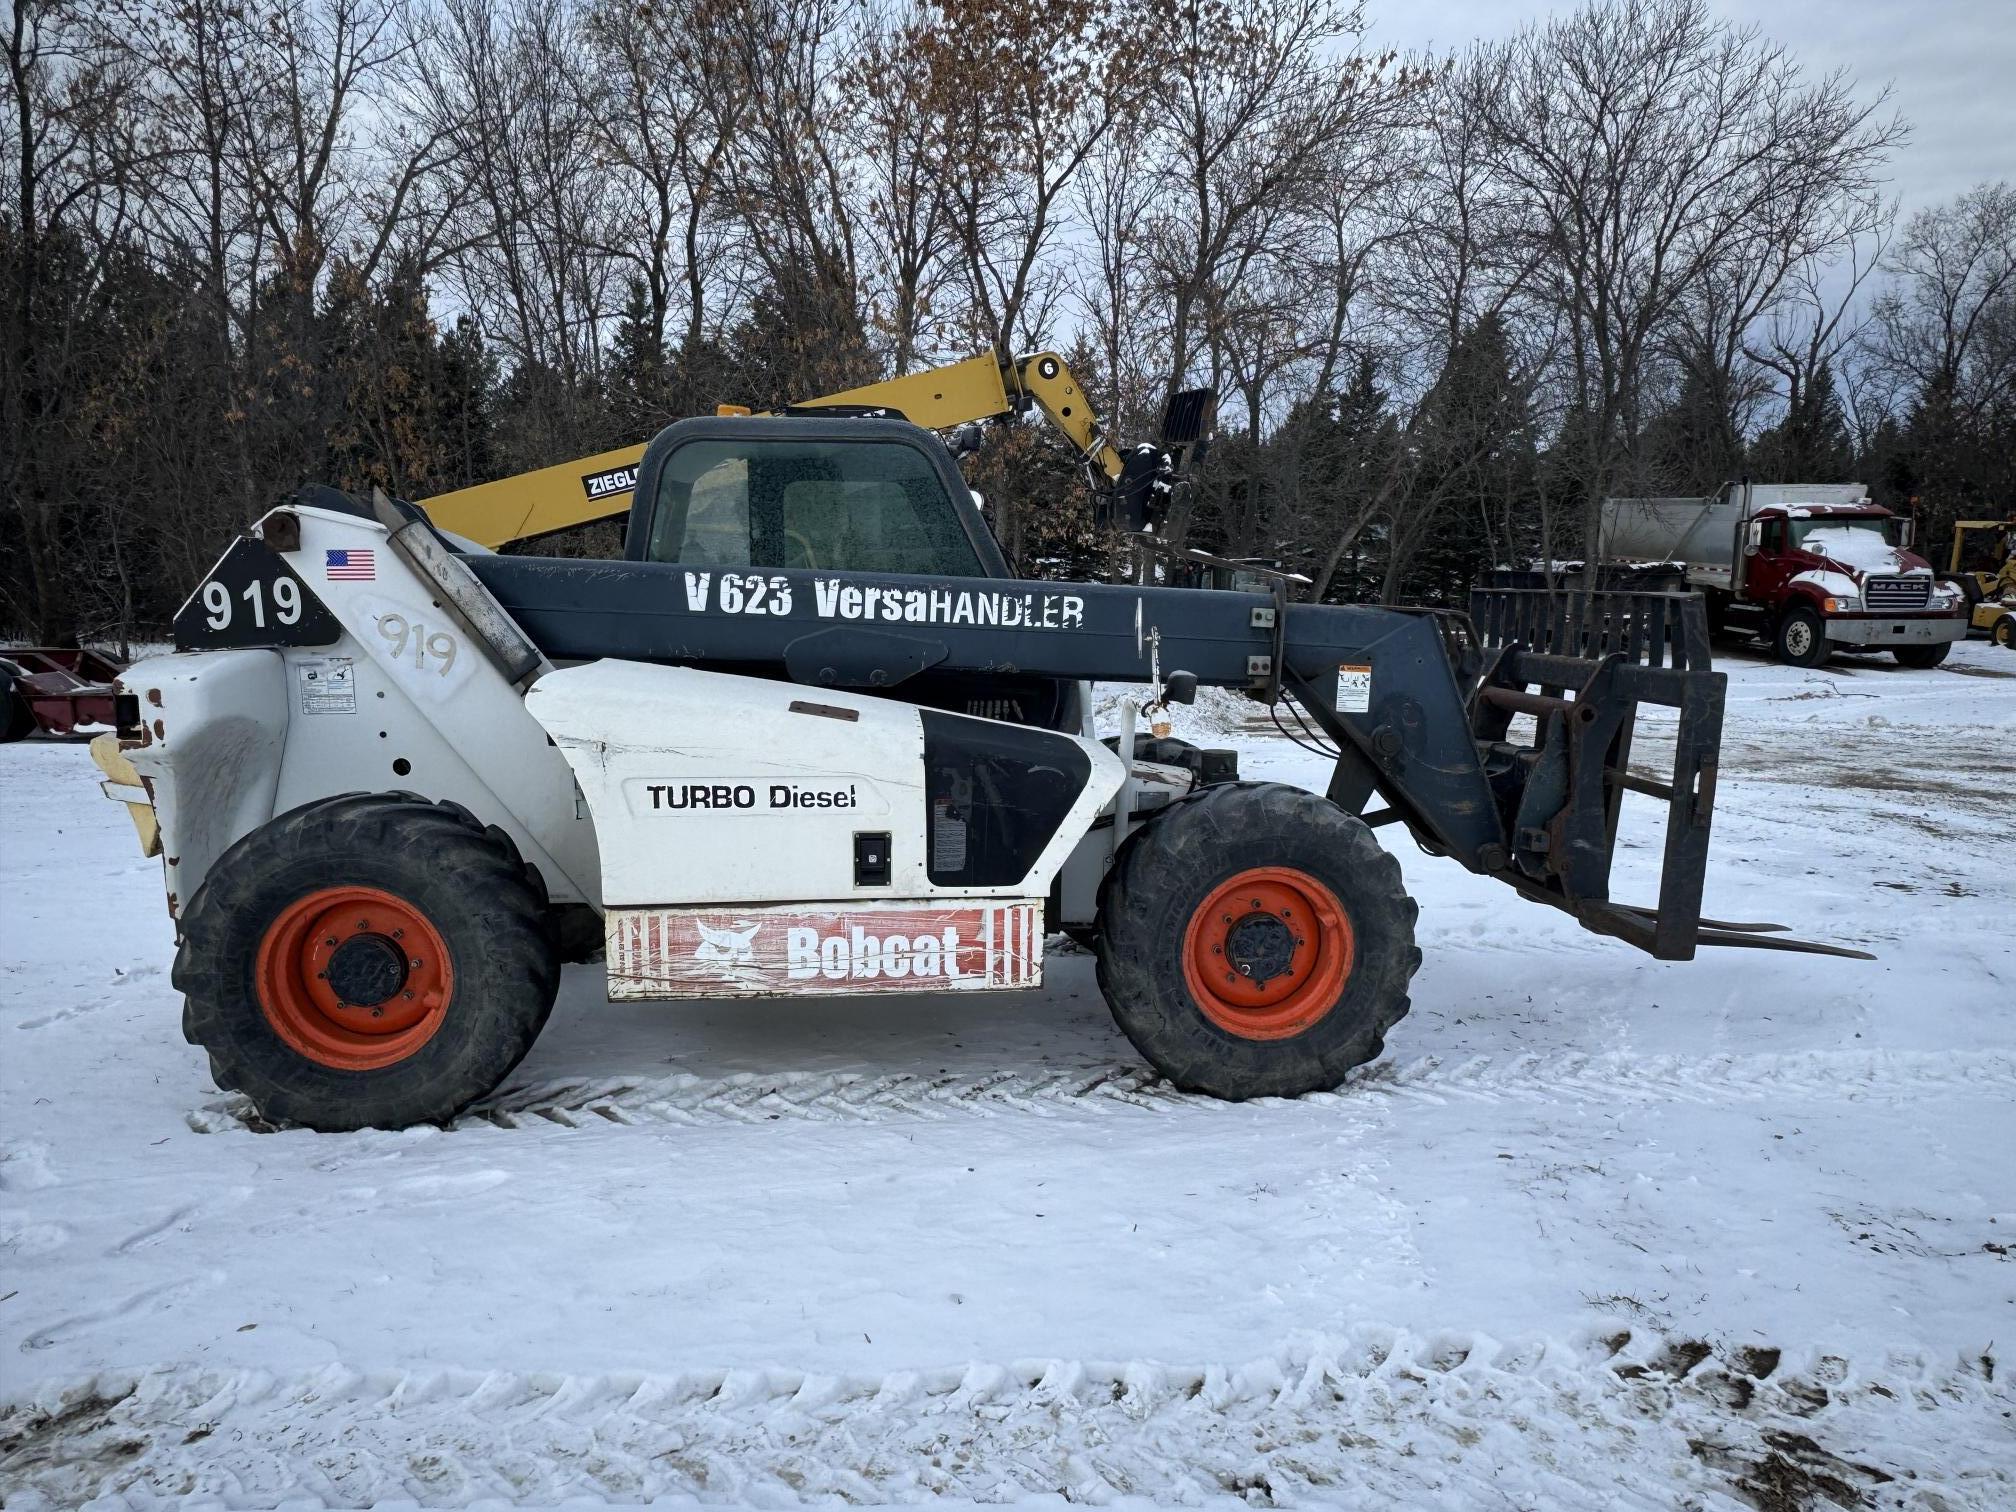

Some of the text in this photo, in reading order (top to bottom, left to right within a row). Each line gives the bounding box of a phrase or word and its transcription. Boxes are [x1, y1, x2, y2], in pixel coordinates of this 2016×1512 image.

[1044, 362, 1054, 375] 6
[202, 576, 302, 630] 919
[684, 571, 711, 612] V
[719, 573, 793, 617] 623
[1871, 583, 1926, 591] MACK
[377, 612, 457, 678] 919
[646, 784, 857, 809] TURBO Diesel
[787, 925, 960, 980] Bobcat
